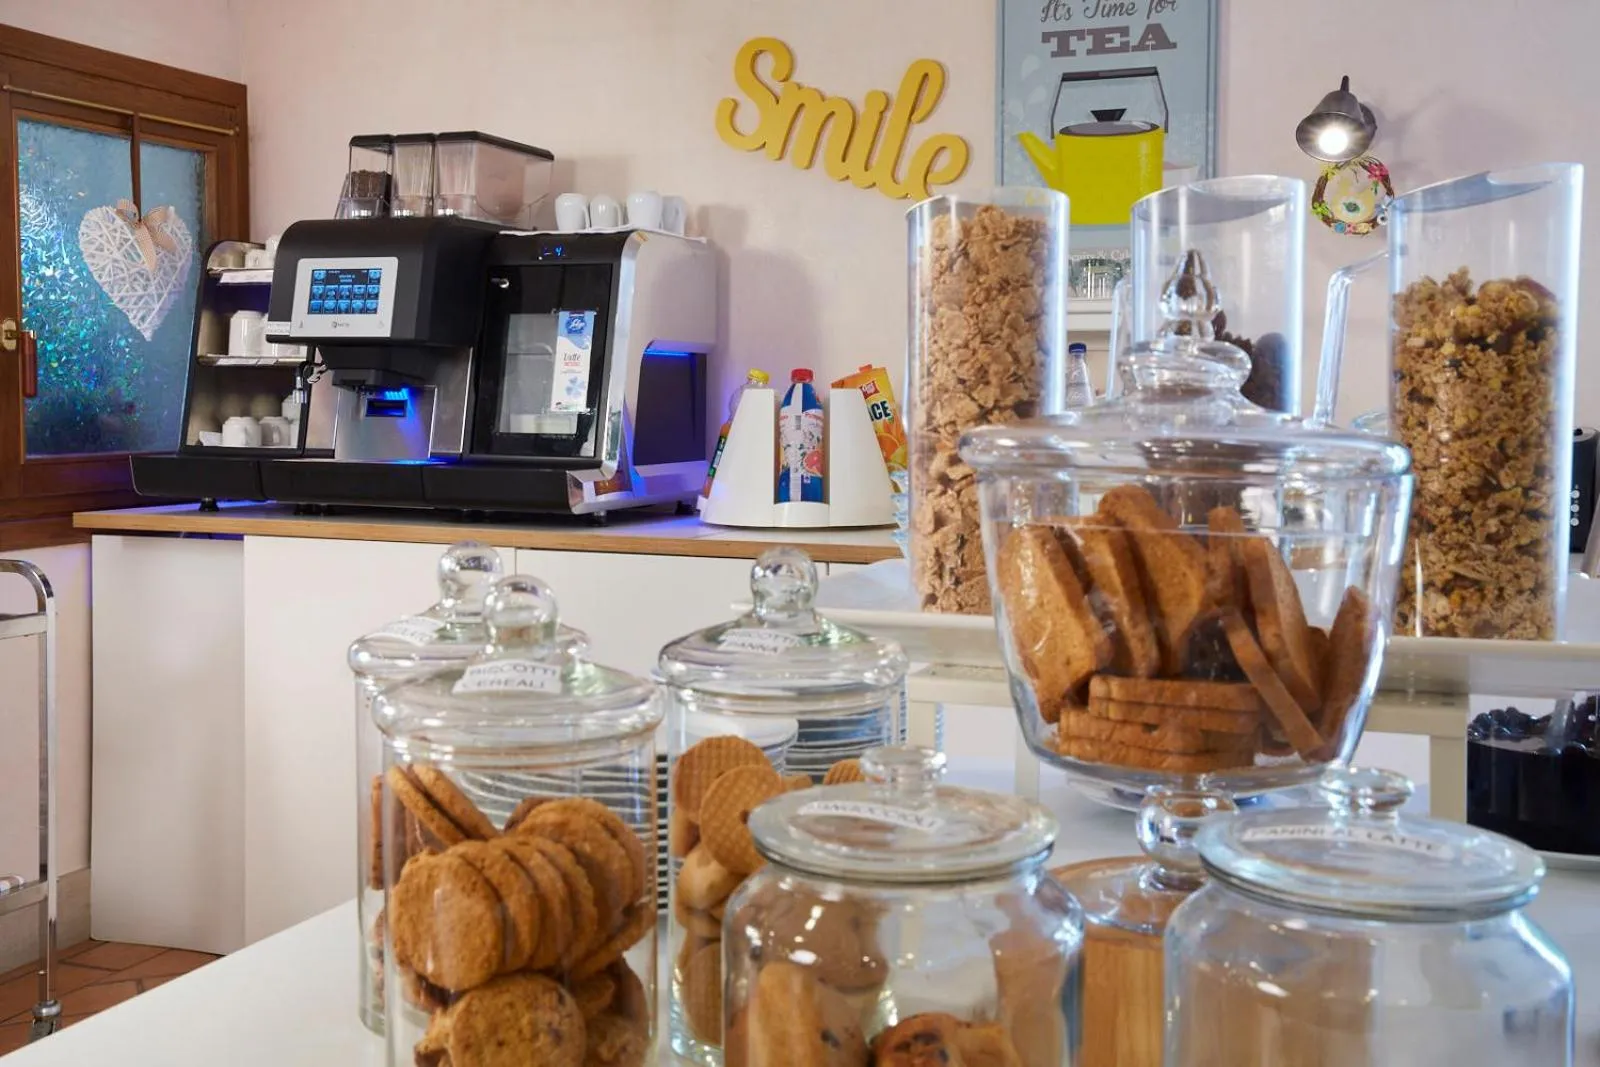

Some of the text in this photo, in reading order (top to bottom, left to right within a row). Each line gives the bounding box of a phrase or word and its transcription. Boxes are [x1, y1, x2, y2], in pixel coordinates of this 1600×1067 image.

[1041, 0, 1073, 22] It's
[1083, 0, 1138, 19] Time
[1041, 23, 1178, 58] TEA
[715, 37, 969, 199] Smile
[468, 660, 558, 676] BISCOTTI
